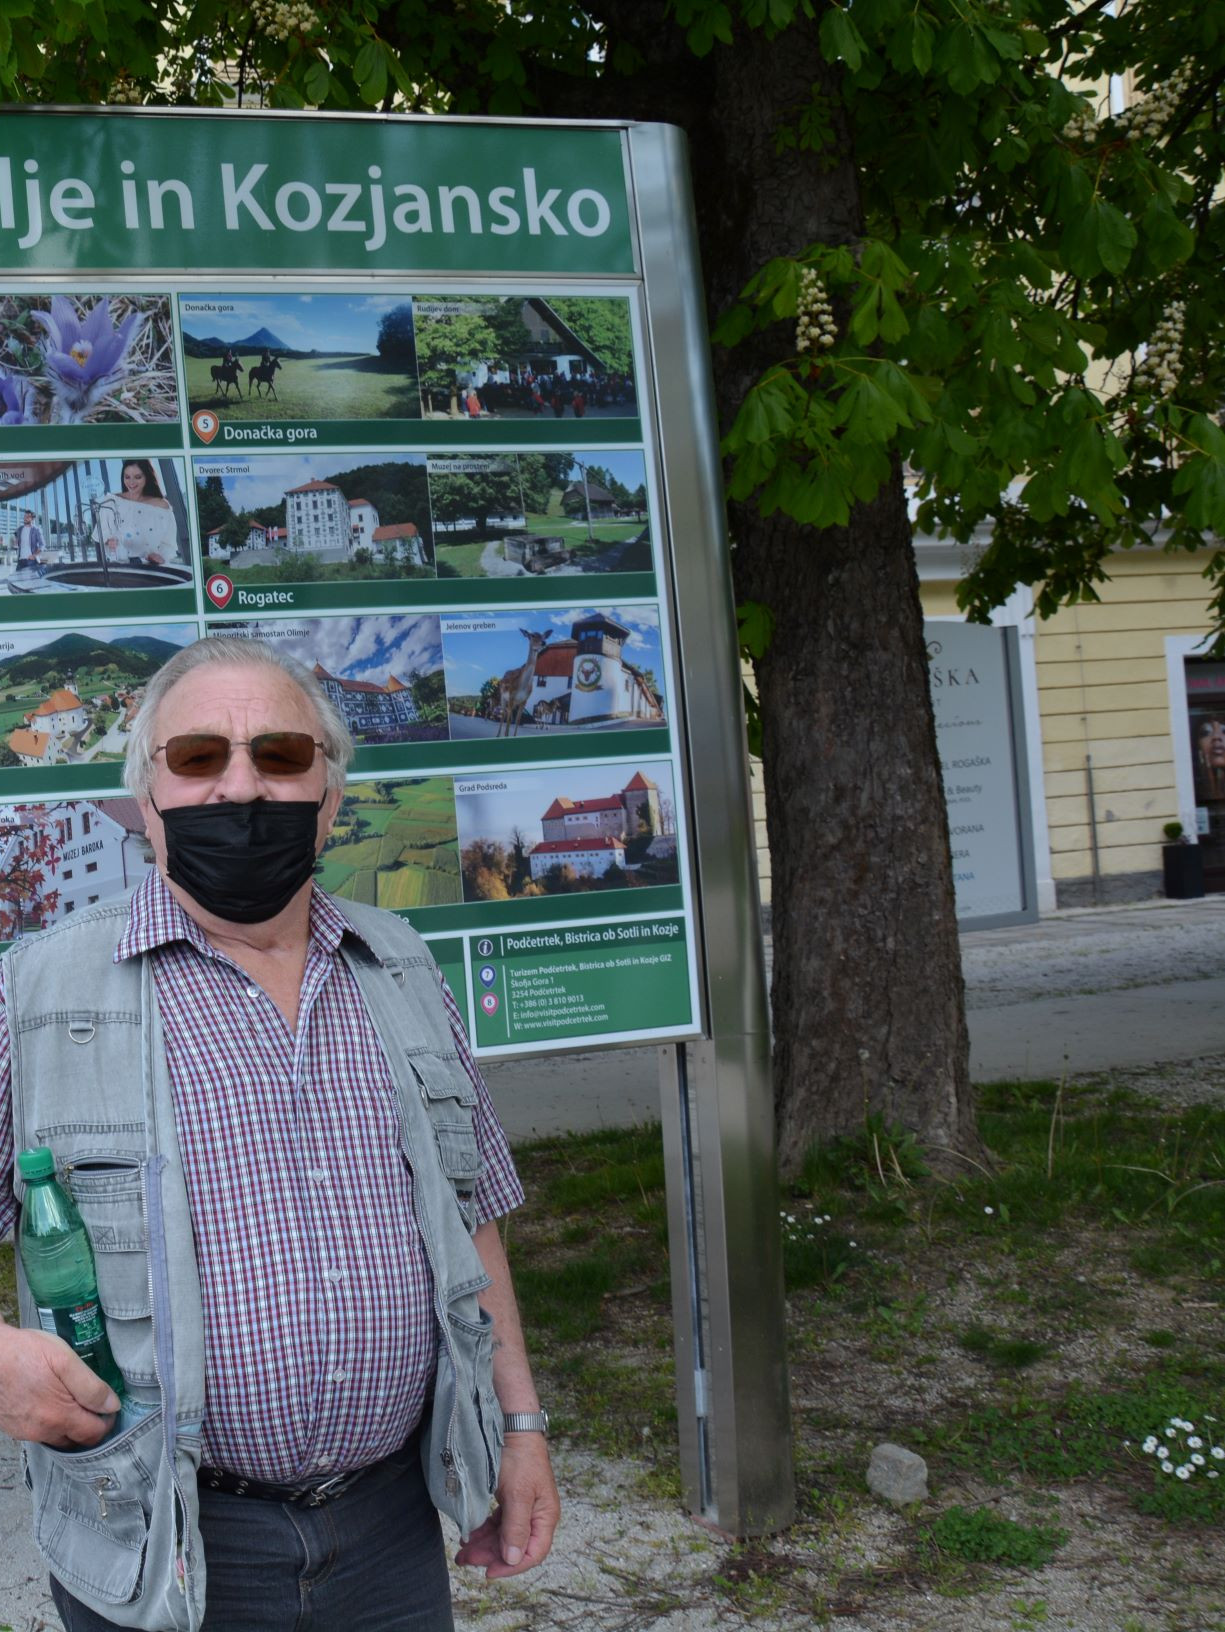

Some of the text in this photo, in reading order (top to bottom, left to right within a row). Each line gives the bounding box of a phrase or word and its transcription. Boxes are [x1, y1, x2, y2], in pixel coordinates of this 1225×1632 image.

[122, 162, 194, 230] in
[222, 163, 612, 251] Kozjansko
[184, 303, 235, 315] Donačka gora
[202, 419, 209, 429] 5
[223, 425, 318, 443] Donačka gora
[10, 469, 25, 479] vod
[198, 464, 250, 475] Dvorec Strmol
[216, 584, 223, 594] 6
[238, 588, 294, 606] Rogatec
[446, 621, 496, 632] Jelenov greben
[250, 630, 285, 639] samostan
[287, 629, 310, 639] Olimje
[951, 756, 992, 769] ROGAŠKA
[458, 781, 508, 792] Grad Podsreda
[63, 840, 104, 861] MUZEJ BAROKA
[507, 923, 679, 950] Podčetrtek, Bistrica ob Sotli in Kozje
[510, 968, 538, 978] Turizem
[579, 960, 605, 971] Bistrica
[606, 959, 615, 968] ob
[615, 957, 632, 967] Sotli
[632, 957, 639, 965] in
[640, 955, 659, 965] Kozje
[511, 978, 532, 989] Škofja
[532, 977, 550, 987] Gora
[512, 985, 566, 999] 3254 Podčetrtek
[512, 1001, 519, 1009] T:
[513, 1011, 520, 1020] E:
[513, 1021, 524, 1031] W:
